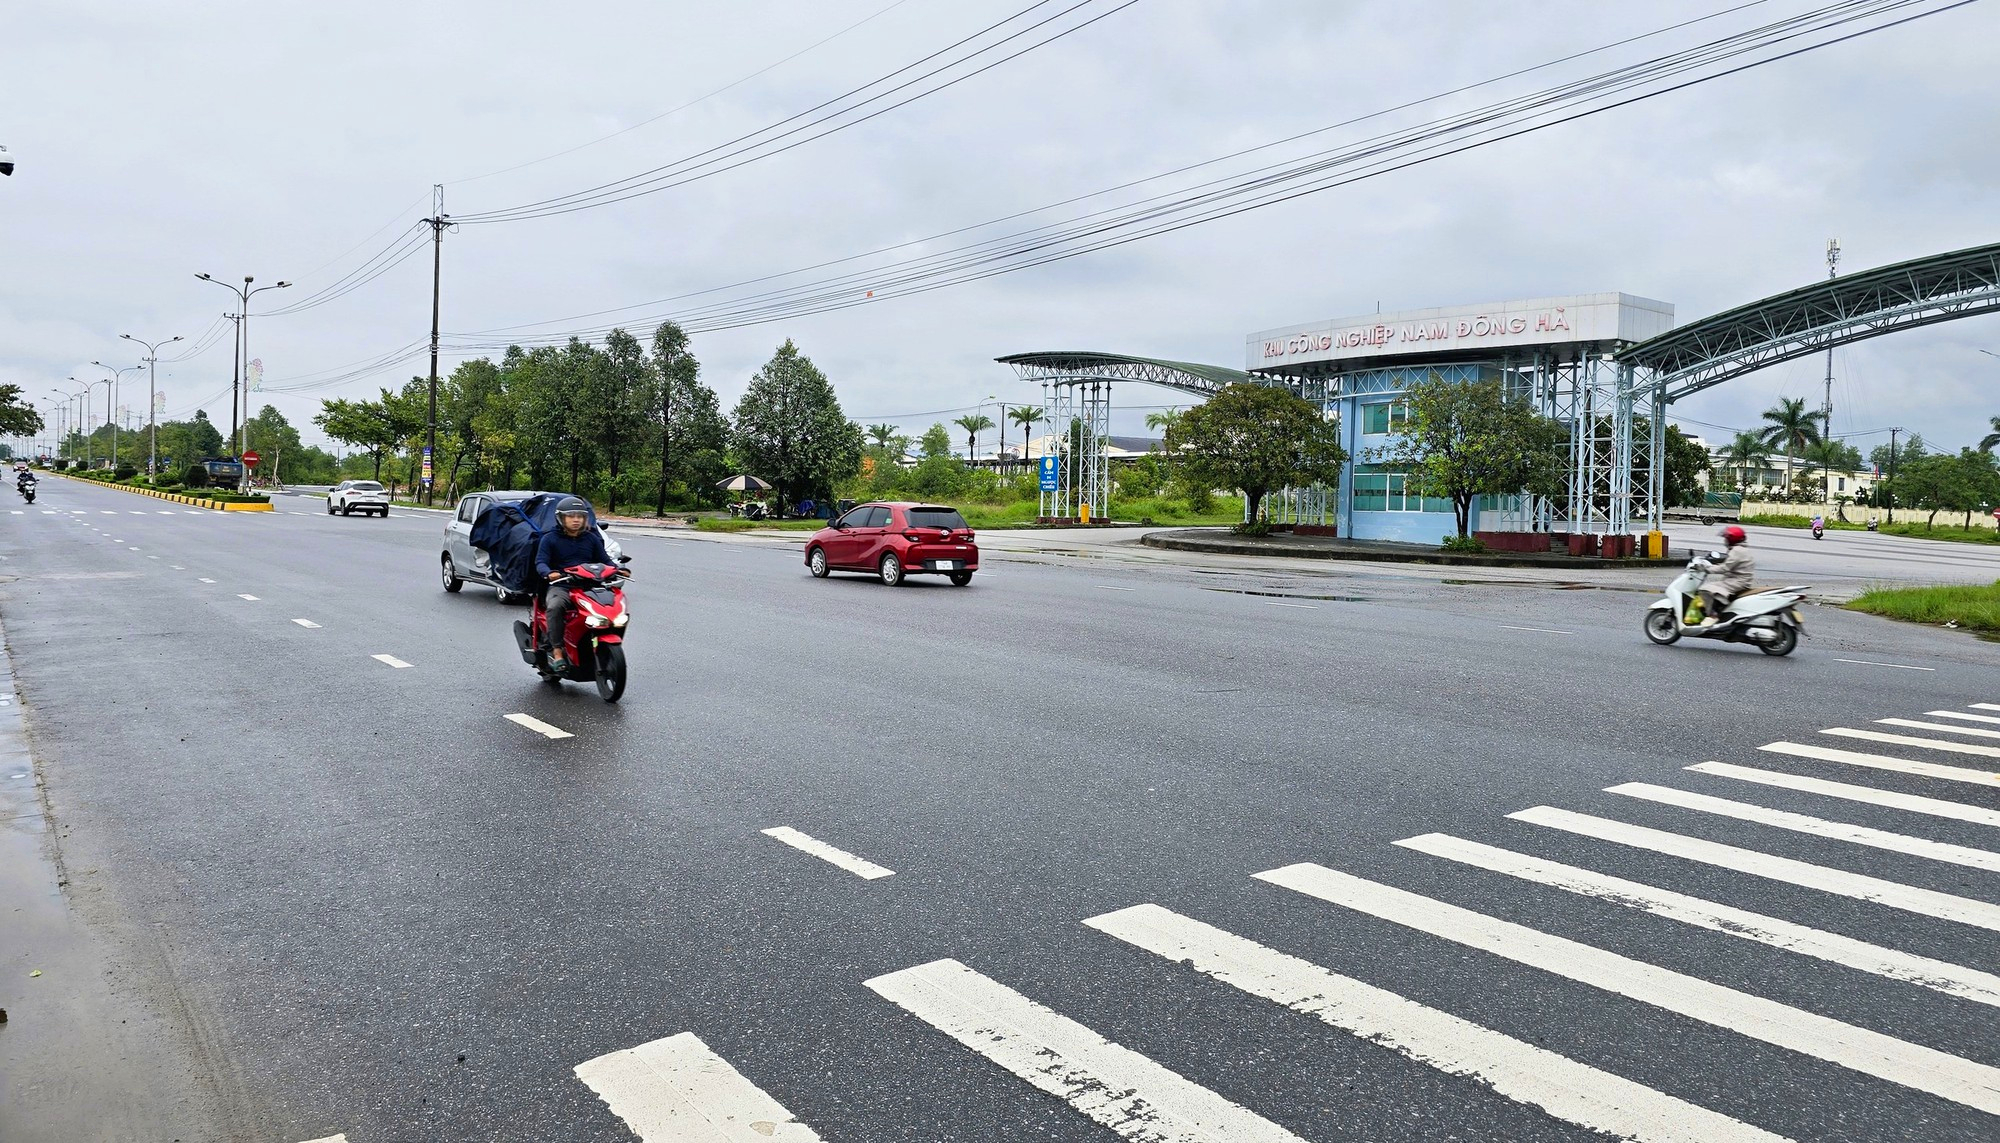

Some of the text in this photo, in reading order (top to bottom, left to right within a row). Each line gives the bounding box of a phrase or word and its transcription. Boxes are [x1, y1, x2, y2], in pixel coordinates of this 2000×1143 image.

[1263, 305, 1569, 358] KHU CÔNG NGHIỆP NAM ĐÔNG HÀ
